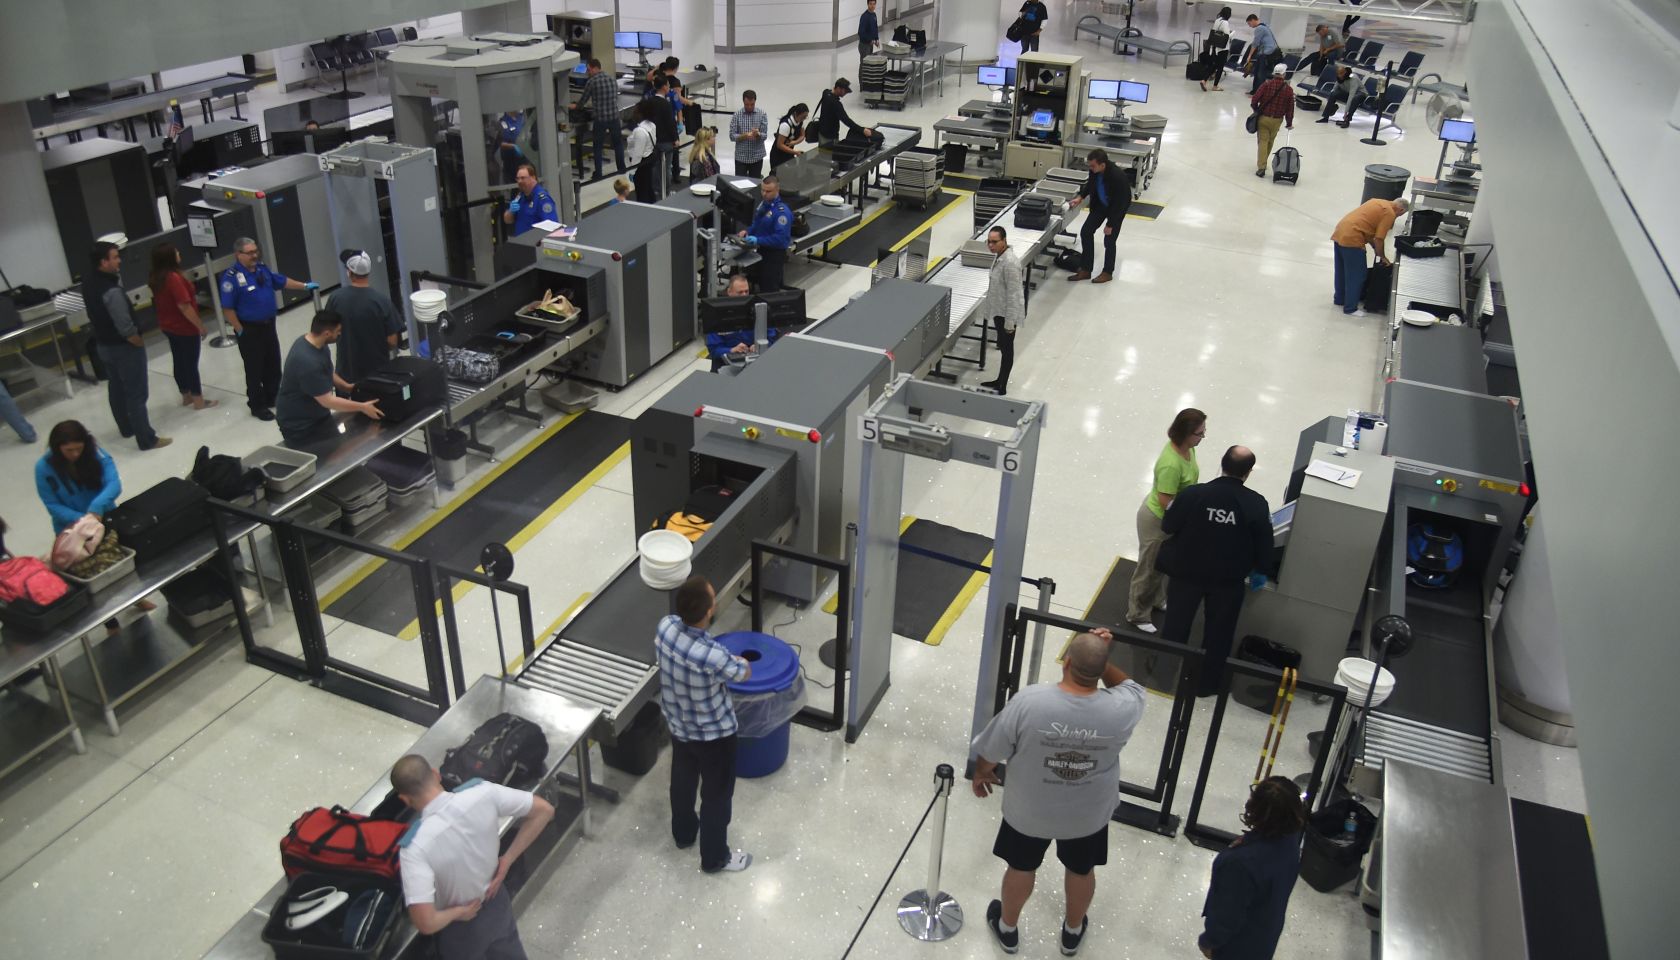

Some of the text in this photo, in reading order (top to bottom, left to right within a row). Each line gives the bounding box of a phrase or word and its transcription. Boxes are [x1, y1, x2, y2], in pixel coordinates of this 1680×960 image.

[321, 157, 329, 170] 3
[385, 166, 393, 178] 4
[863, 420, 877, 440] 5
[1003, 451, 1018, 472] 6
[1206, 507, 1236, 525] TSA
